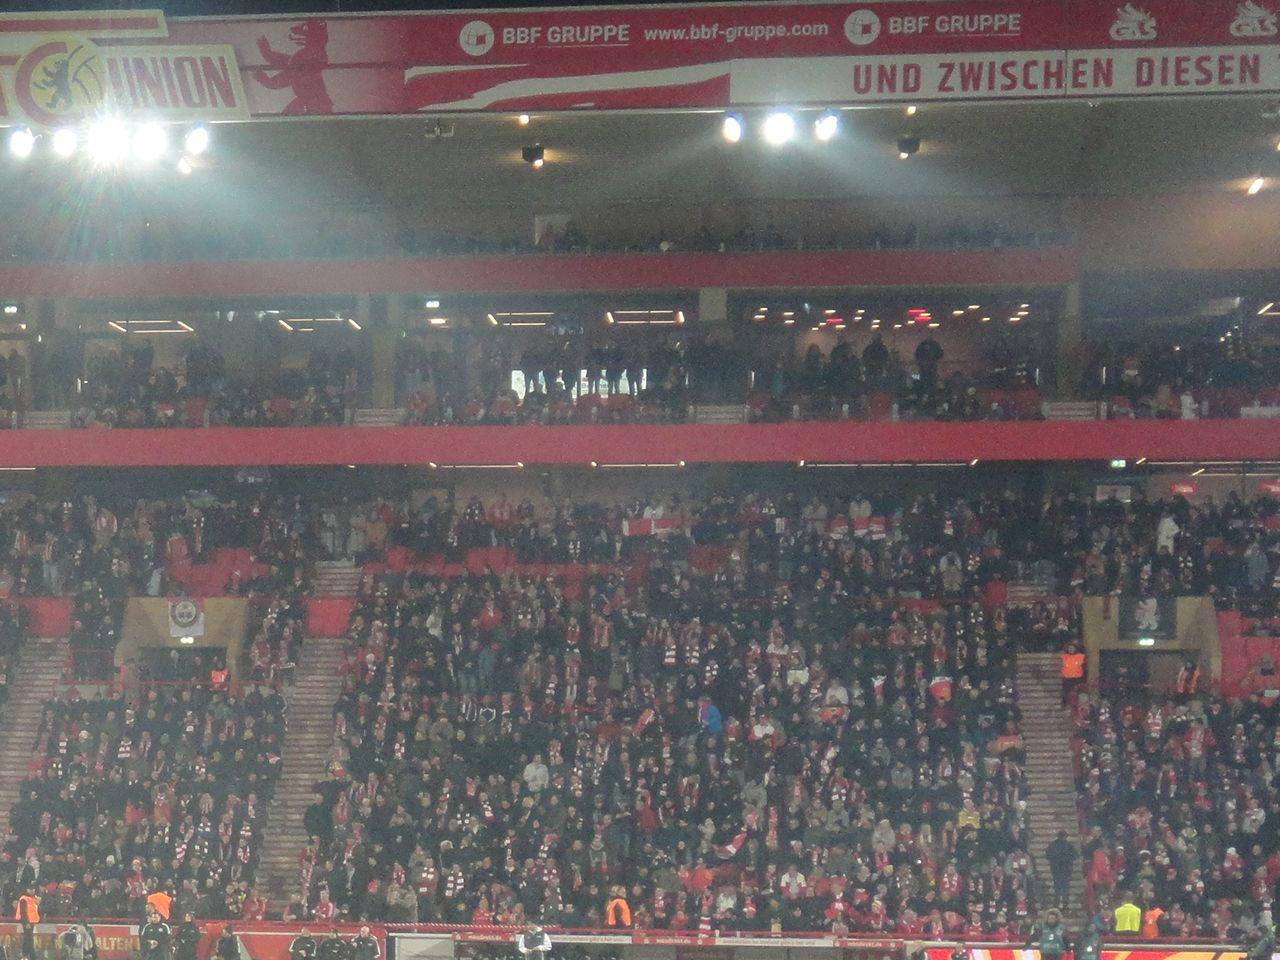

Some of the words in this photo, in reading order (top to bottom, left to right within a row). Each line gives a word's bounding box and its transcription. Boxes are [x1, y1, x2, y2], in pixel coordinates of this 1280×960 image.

[502, 27, 540, 44] BBF
[547, 24, 630, 43] GRUPPE
[644, 22, 828, 42] www.bbf-gruppe.com
[888, 17, 928, 34] BBF
[935, 14, 1021, 33] GRUPPE
[853, 63, 921, 94] UND
[938, 57, 1113, 92] ZWISCHEN
[1136, 54, 1260, 88] DIESEN
